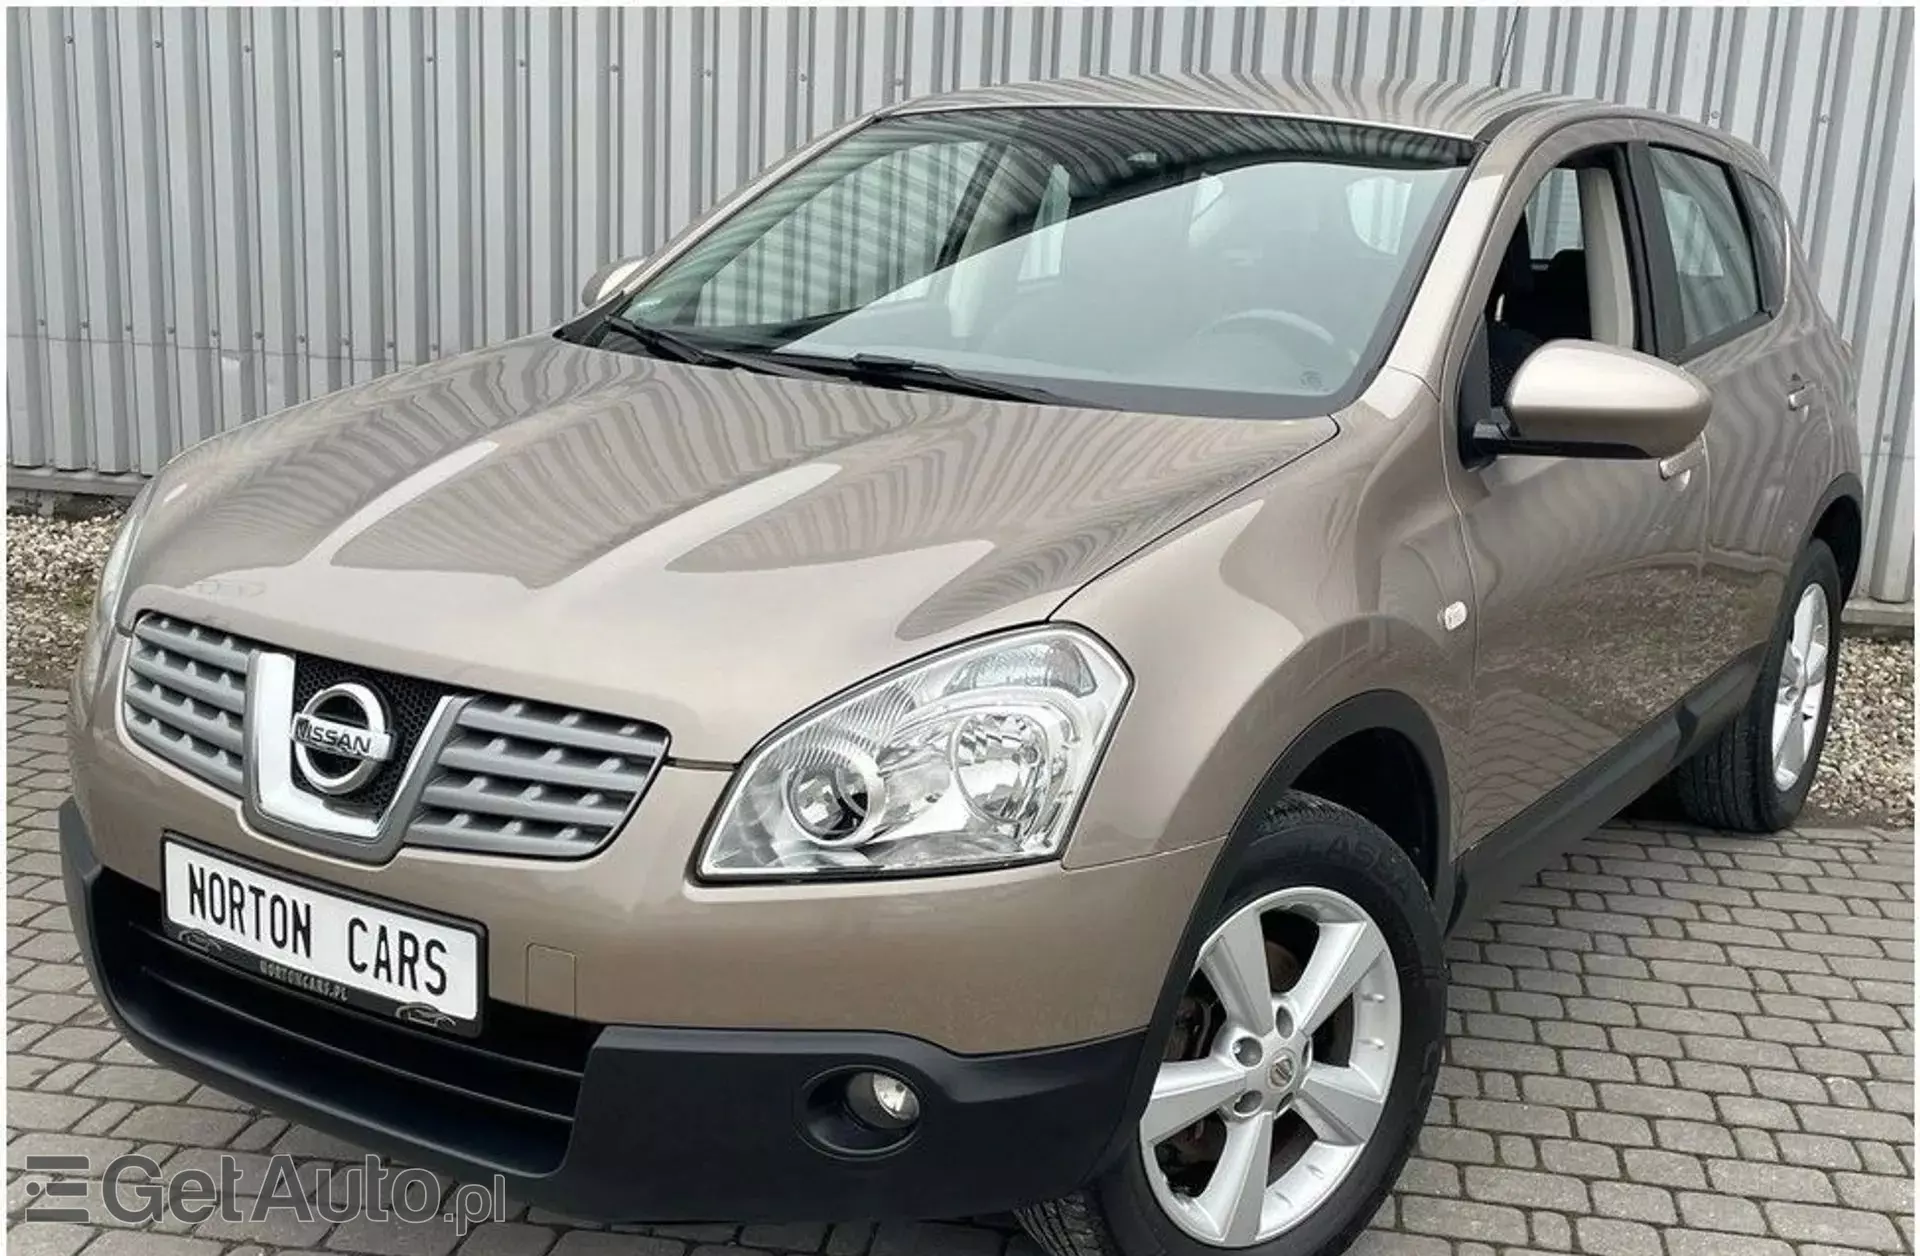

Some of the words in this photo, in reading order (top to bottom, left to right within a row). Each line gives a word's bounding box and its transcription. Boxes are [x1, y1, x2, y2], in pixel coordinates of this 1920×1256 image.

[295, 717, 371, 753] NISSAN
[188, 863, 312, 958] NORTON
[348, 918, 447, 996] CARS
